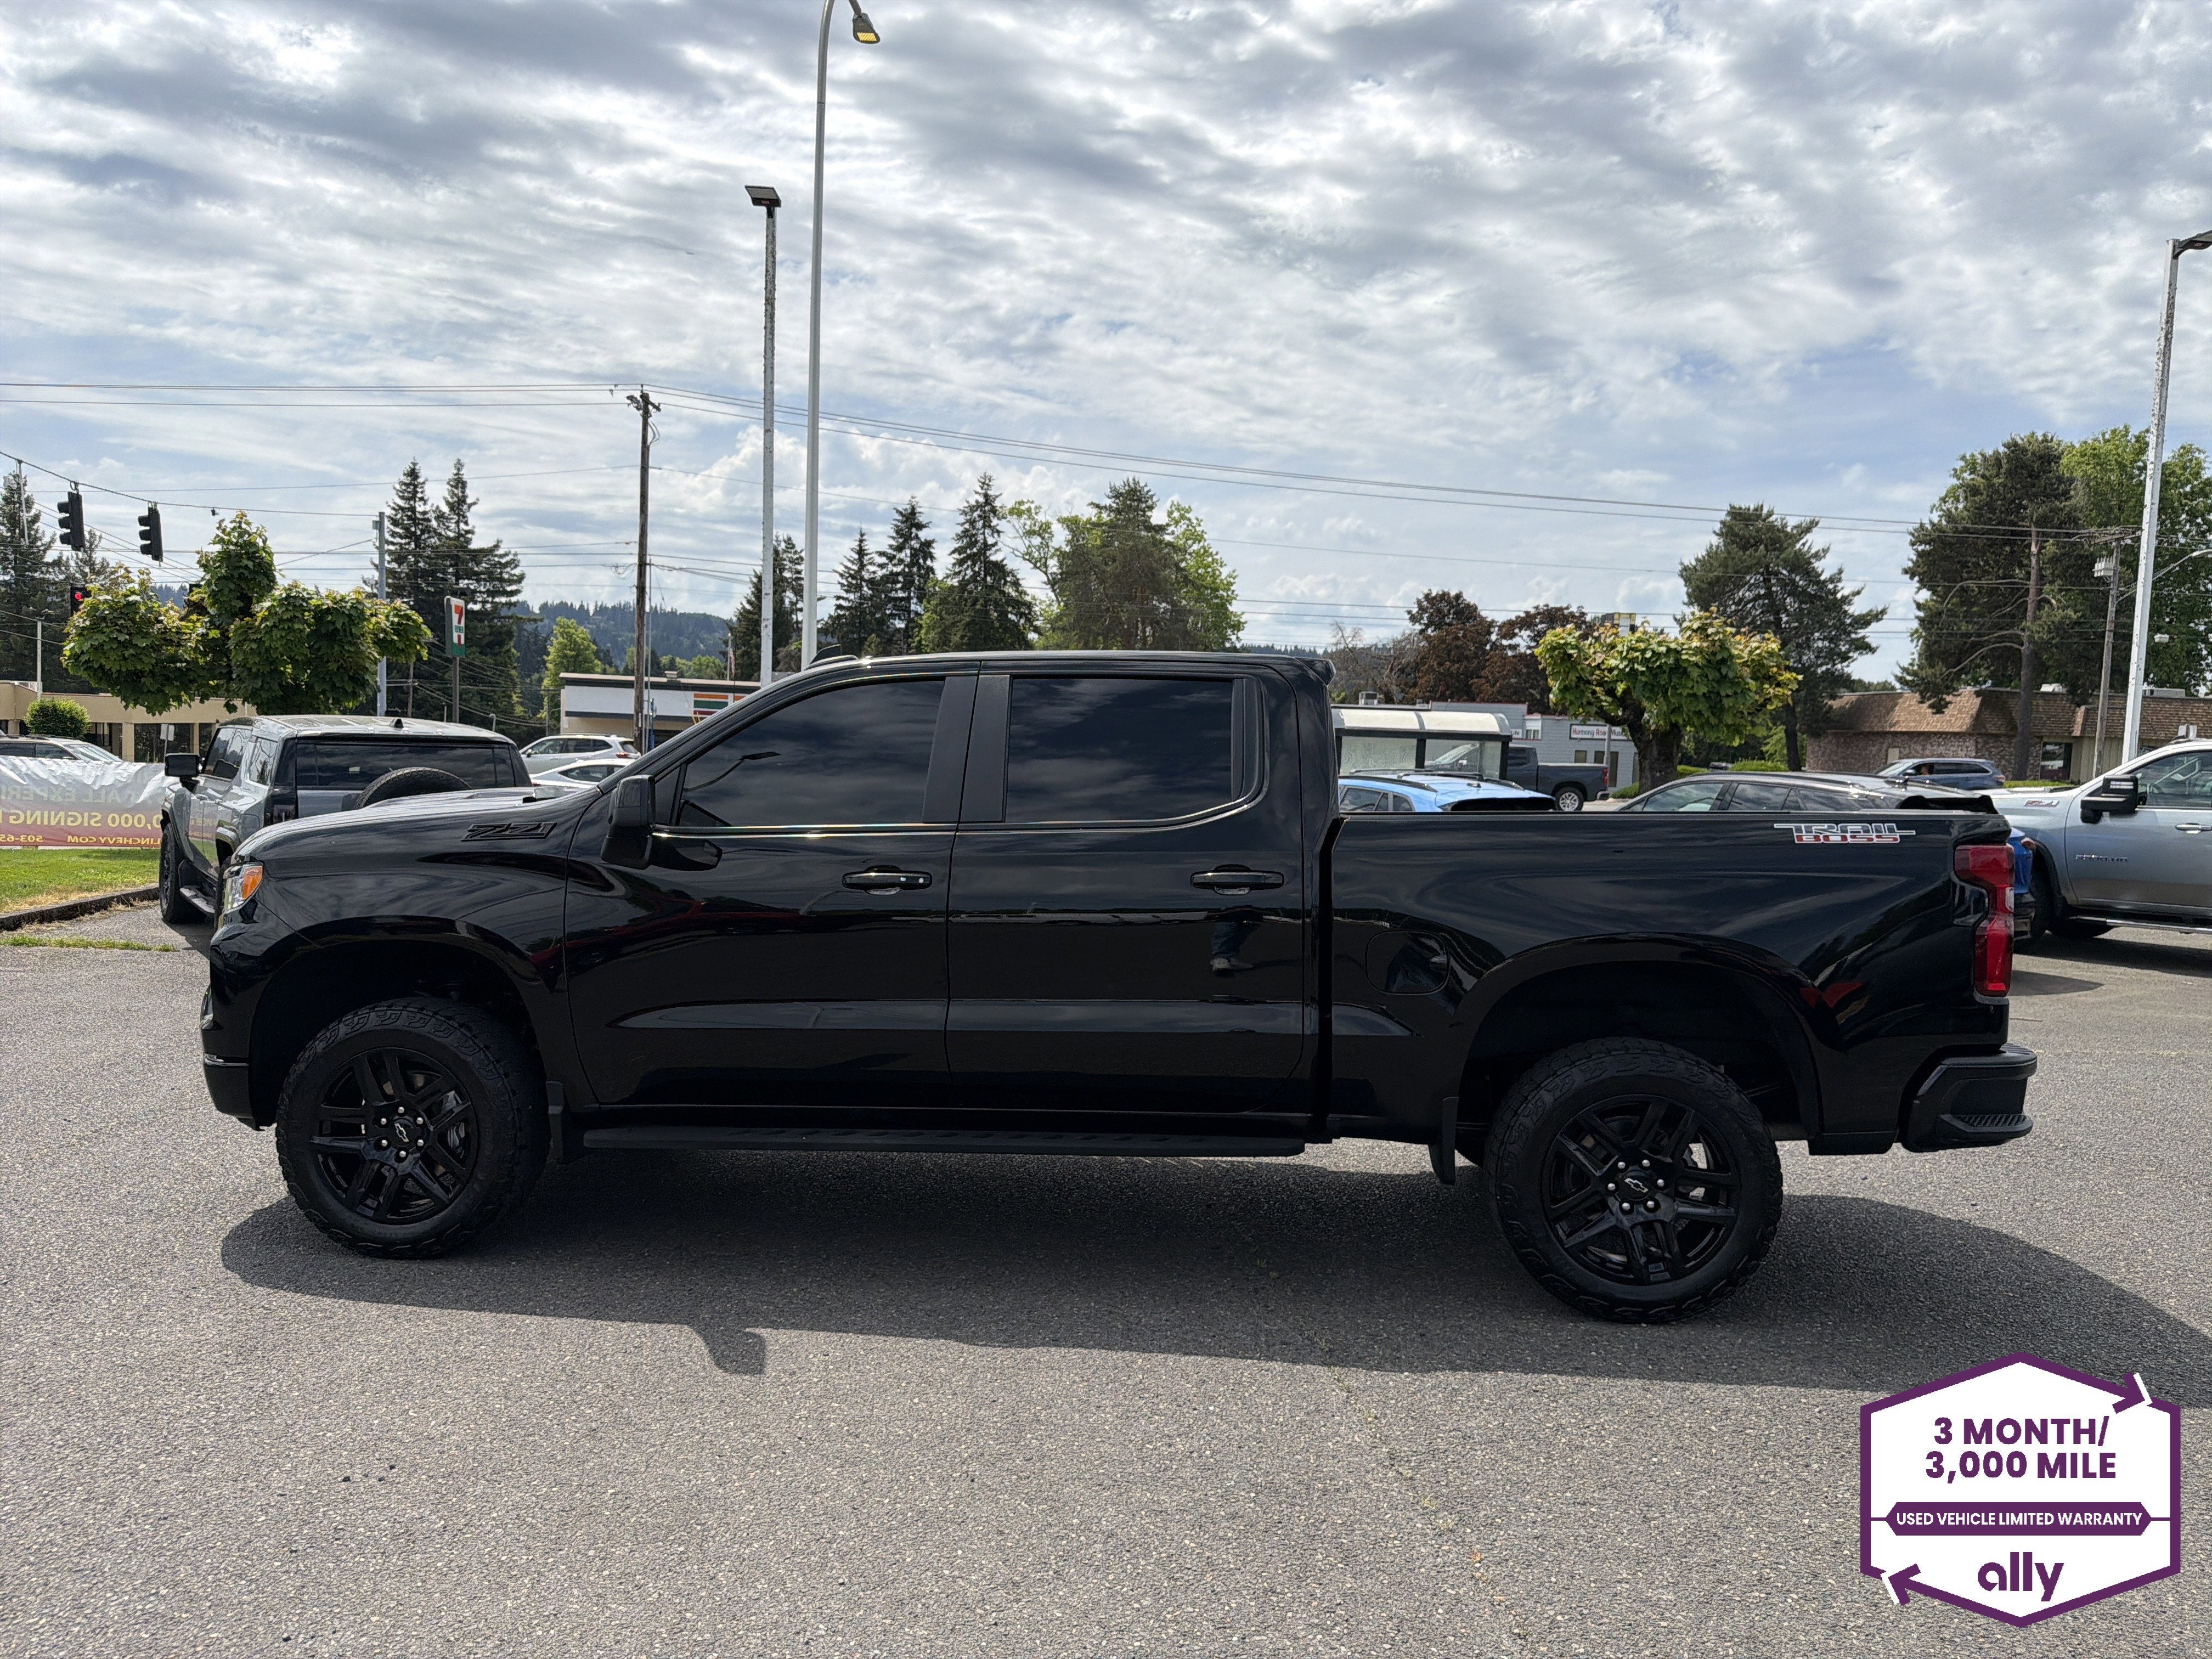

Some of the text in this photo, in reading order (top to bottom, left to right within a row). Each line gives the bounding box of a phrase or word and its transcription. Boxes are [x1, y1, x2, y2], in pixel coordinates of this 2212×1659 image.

[1572, 727, 1595, 738] Harmony
[461, 822, 557, 842] Z71
[1774, 823, 1916, 835] TRAIL
[1795, 834, 1900, 844] BOSS
